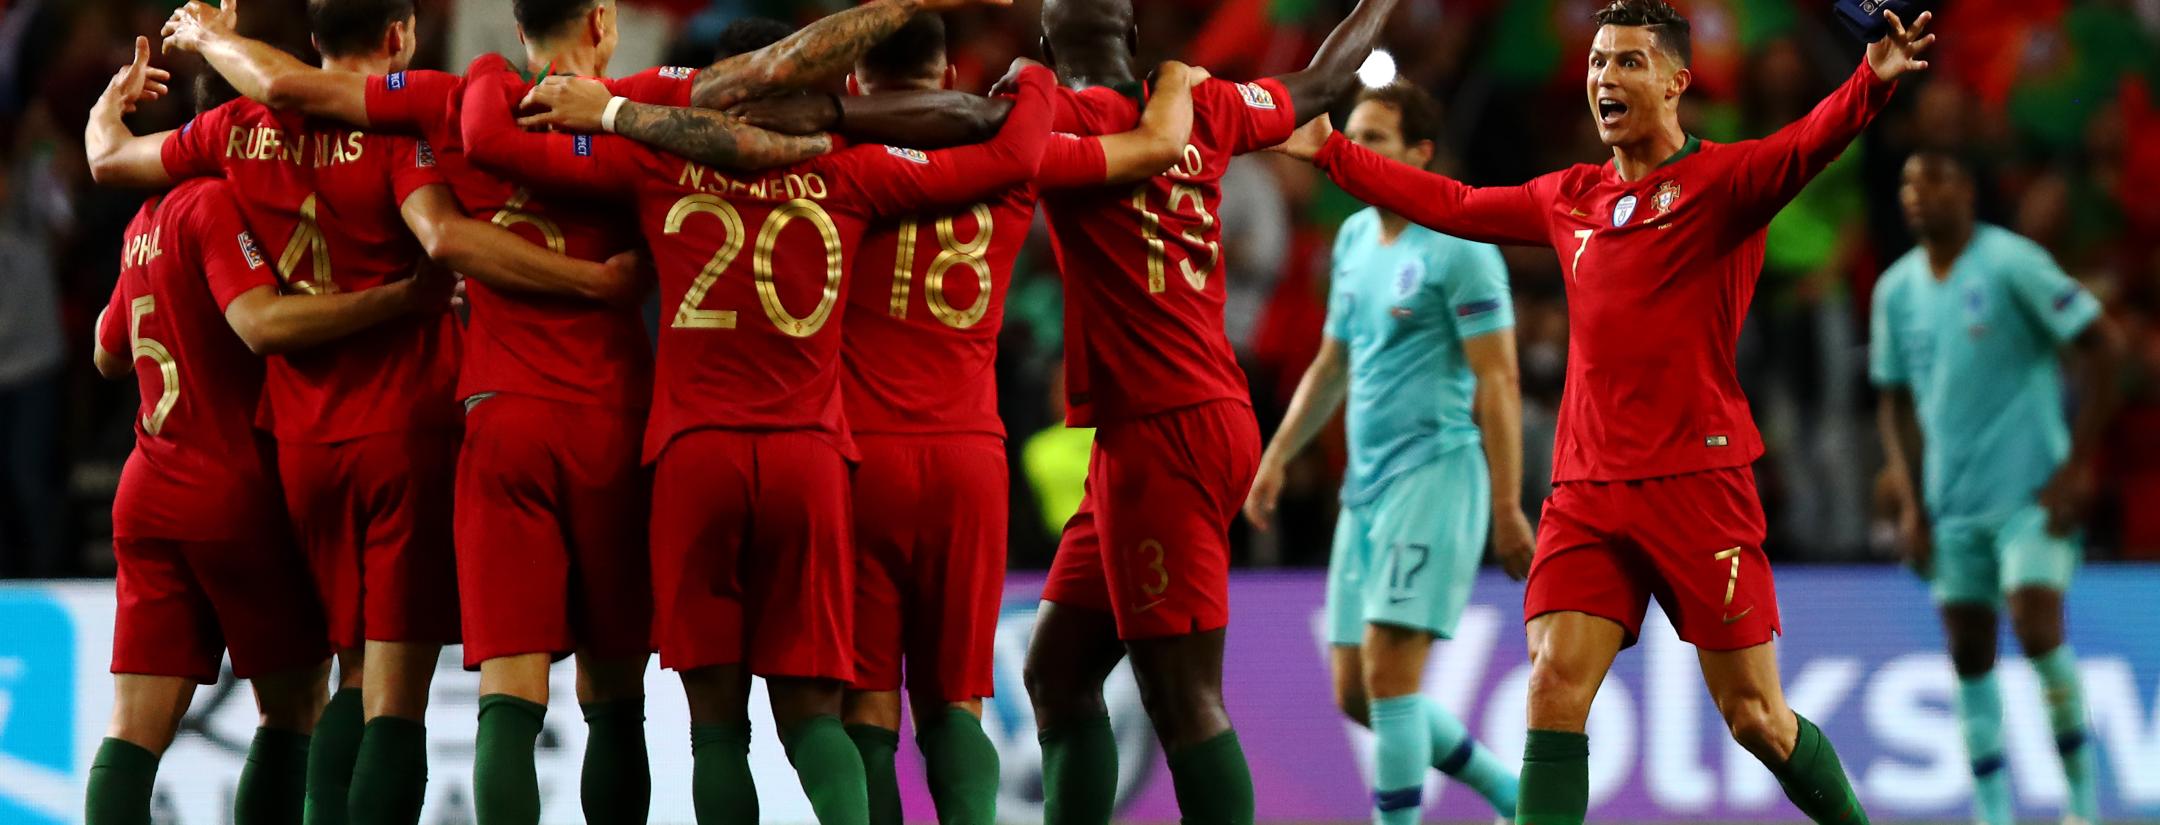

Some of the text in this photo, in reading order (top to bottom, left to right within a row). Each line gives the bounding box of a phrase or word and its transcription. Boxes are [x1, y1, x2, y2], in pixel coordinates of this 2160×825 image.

[277, 191, 334, 294] 4
[664, 193, 842, 338] 20
[889, 203, 993, 329] 18
[1132, 184, 1219, 292] 13
[1572, 229, 1594, 283] 7
[131, 294, 180, 436] 5
[1386, 543, 1430, 588] 17
[1714, 546, 1741, 605] 7
